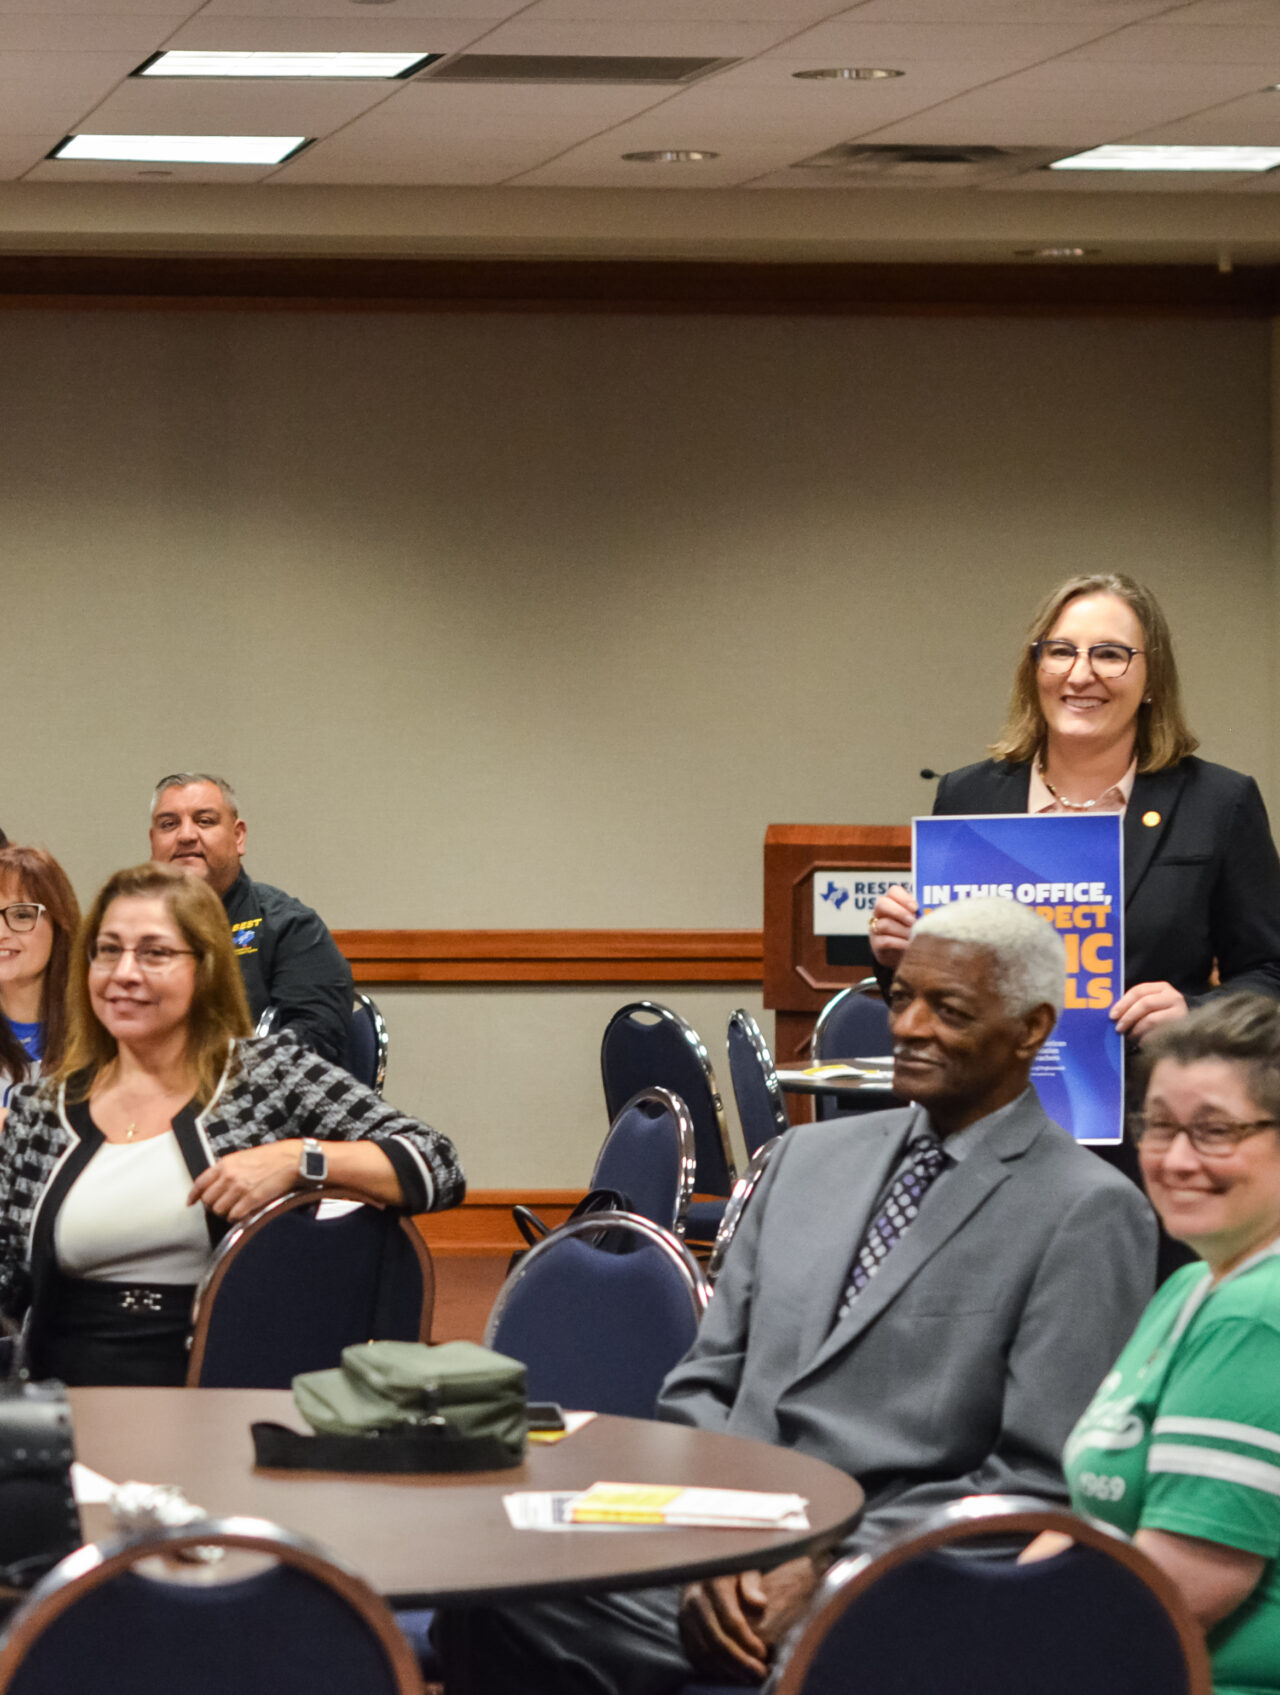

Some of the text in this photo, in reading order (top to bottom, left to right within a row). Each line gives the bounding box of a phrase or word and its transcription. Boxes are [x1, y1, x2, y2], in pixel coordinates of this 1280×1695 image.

[922, 882, 1112, 905] IN THIS OFFICE,
[1032, 905, 1111, 929] PECT
